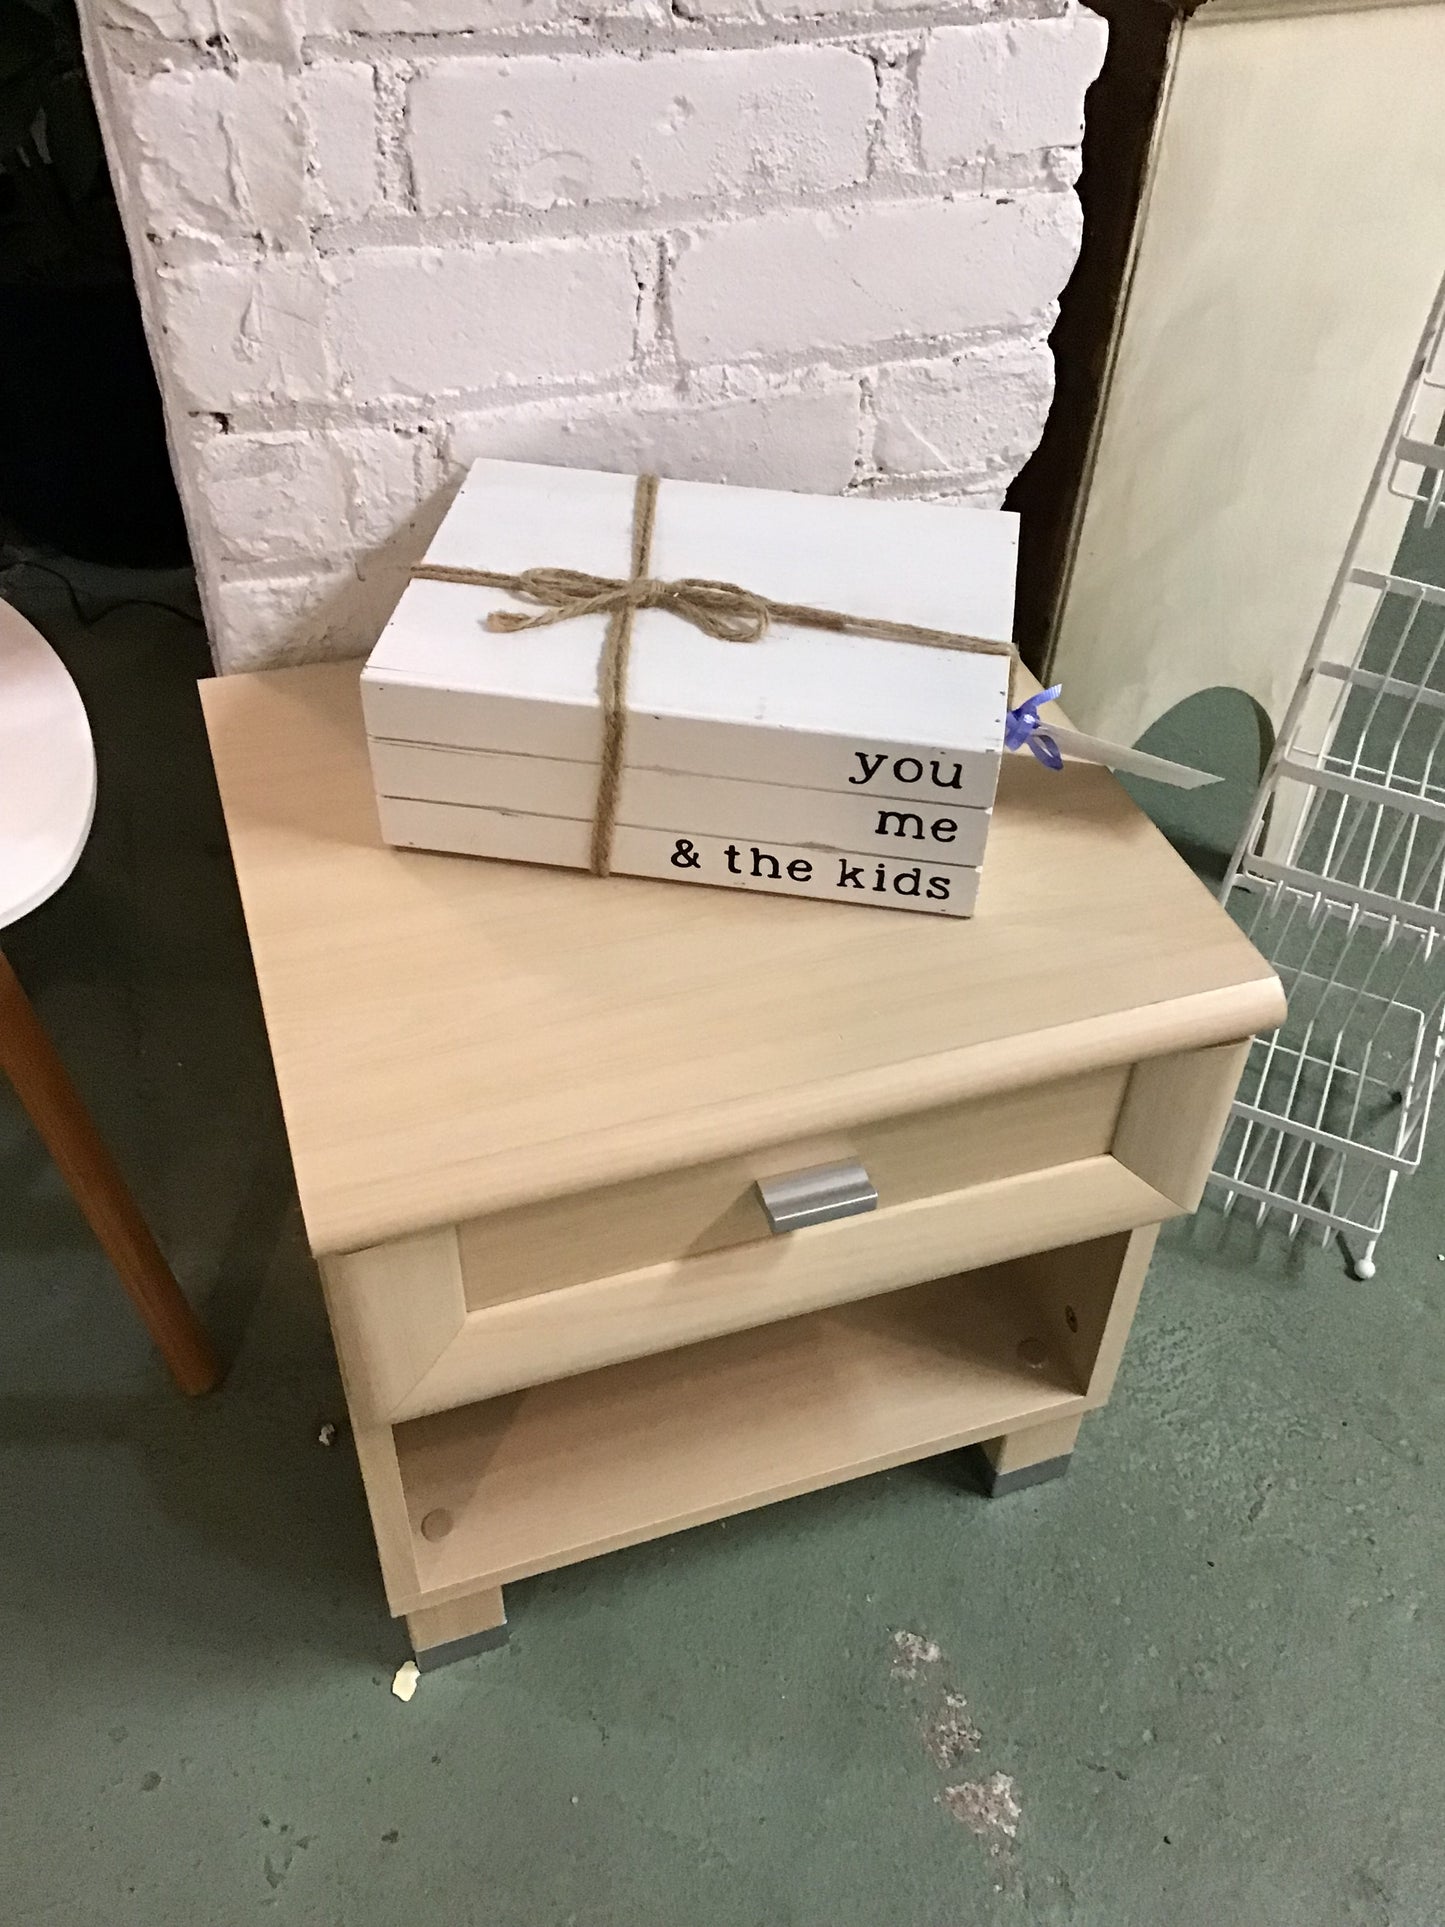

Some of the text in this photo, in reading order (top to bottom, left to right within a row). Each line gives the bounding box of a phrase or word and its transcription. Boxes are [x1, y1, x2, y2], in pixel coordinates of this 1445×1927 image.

[848, 751, 963, 790] you
[874, 810, 958, 843] me
[670, 838, 951, 900] & the kids
